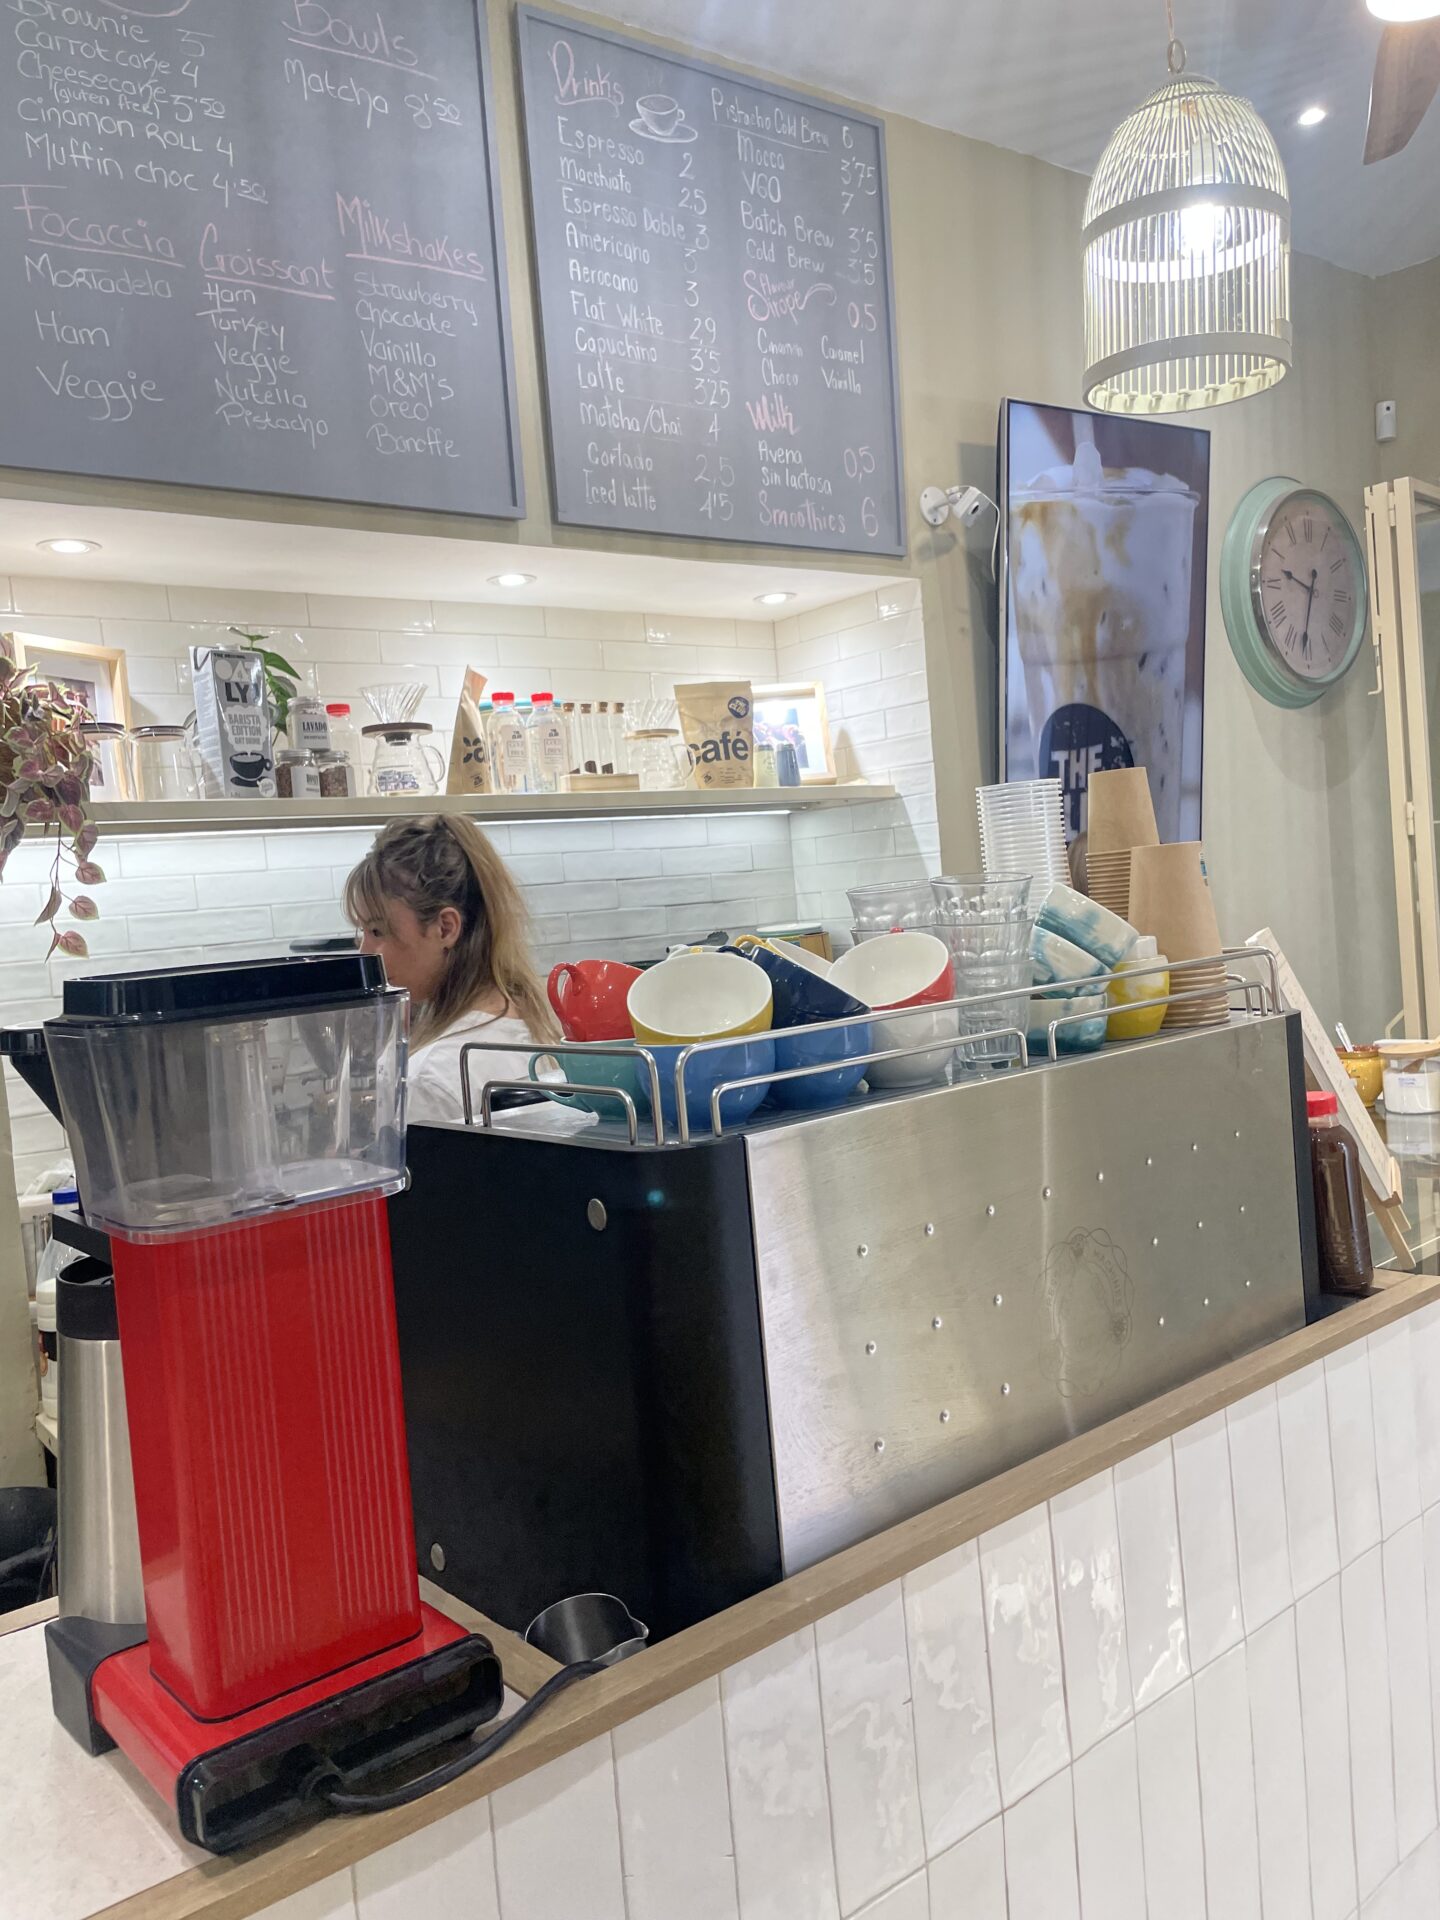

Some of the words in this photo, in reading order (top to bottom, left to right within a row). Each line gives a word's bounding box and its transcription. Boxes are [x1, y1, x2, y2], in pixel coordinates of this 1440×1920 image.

[15, 19, 112, 62] Carrot
[115, 51, 172, 78] cake
[181, 61, 199, 88] 4
[176, 29, 216, 58] 5
[281, 0, 418, 66] Bowls
[17, 49, 169, 106] Cheesecake
[284, 58, 388, 130] Matcha
[551, 40, 624, 108] Drinks
[17, 97, 135, 138] Cinamon
[145, 122, 204, 153] ROLL
[216, 137, 234, 168] 4
[558, 116, 644, 165] Espresso
[679, 153, 695, 179] 2
[737, 128, 785, 170] Mocca
[774, 108, 796, 137] Cold
[842, 126, 853, 148] 6
[24, 131, 124, 180] Muffin
[135, 161, 199, 191] choc
[743, 171, 781, 203] V60
[841, 192, 854, 214] 7
[0, 184, 175, 258] Focaccia
[336, 191, 484, 275] Milkshakes
[562, 187, 637, 228] Espresso
[643, 207, 686, 239] Doble
[695, 224, 710, 250] 3
[740, 200, 786, 237] Batch
[794, 216, 833, 248] Brew
[199, 222, 336, 289] Croissant
[566, 222, 650, 264] Americano
[684, 248, 699, 275] 3
[746, 239, 775, 262] Cold
[787, 246, 824, 273] Brew
[203, 282, 256, 309] Ham
[354, 271, 478, 326] Strawberry
[569, 259, 638, 293] Aerocano
[685, 281, 700, 307] 3
[35, 310, 110, 347] Ham
[195, 308, 284, 352] Turkey
[355, 299, 457, 337] Chocolate
[570, 290, 606, 321] Flat
[617, 304, 664, 336] White
[214, 335, 298, 385] Veggie
[575, 327, 657, 364] Capuchino
[36, 360, 164, 421] Veggie
[214, 371, 307, 408] Nutella
[368, 363, 454, 407] M&M's
[578, 362, 624, 393] Latte
[762, 357, 799, 386] Choco
[215, 401, 328, 450] Pistacho
[369, 394, 429, 421] Oreo
[709, 413, 720, 441] 4
[746, 393, 798, 435] Milk
[588, 442, 653, 472] Cortado
[759, 440, 801, 464] Avena
[583, 469, 616, 506] Iced
[761, 466, 781, 487] Sin
[786, 467, 832, 496] lactosa
[759, 490, 846, 533] Smoothies
[862, 497, 878, 537] 6
[228, 713, 261, 725] BARISTA
[231, 724, 262, 737] EDITION
[687, 731, 749, 766] café
[1051, 743, 1103, 790] THE
